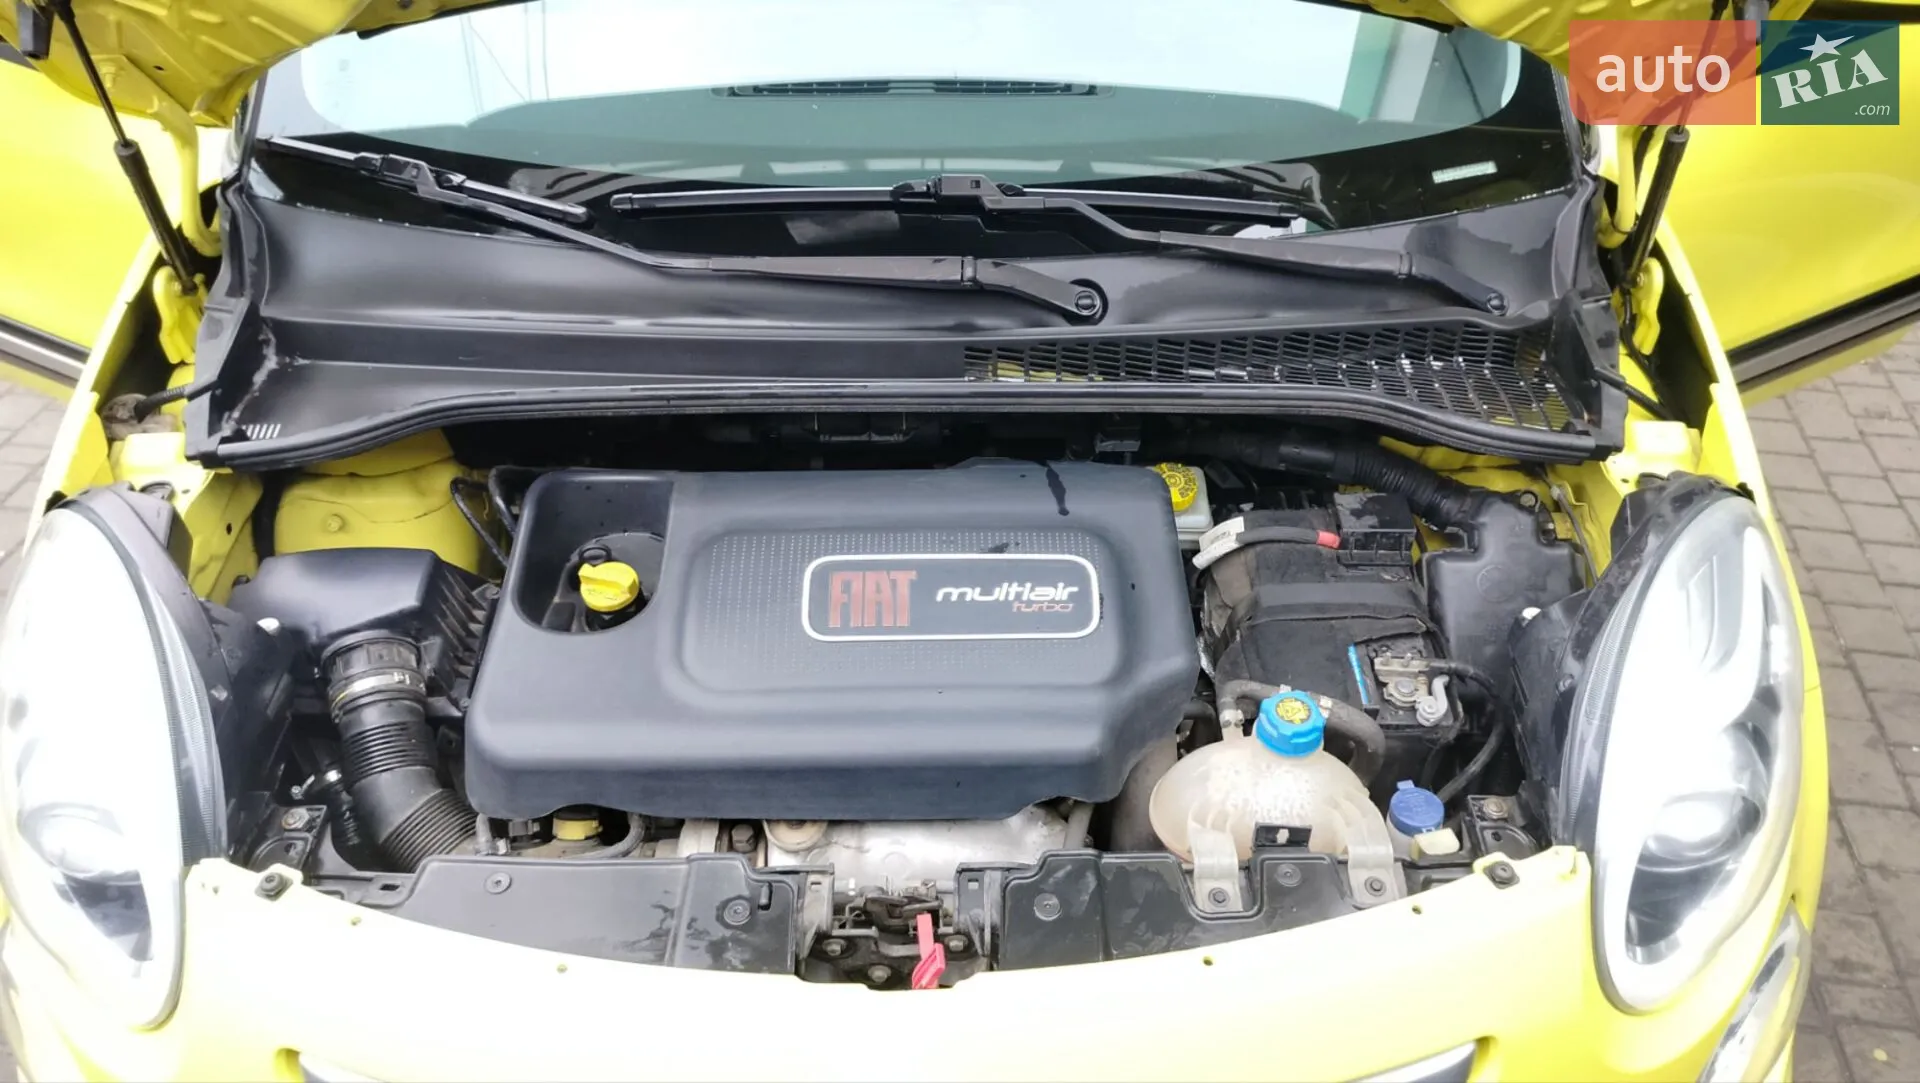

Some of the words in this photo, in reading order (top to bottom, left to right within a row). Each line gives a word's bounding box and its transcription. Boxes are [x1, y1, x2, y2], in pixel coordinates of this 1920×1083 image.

[828, 570, 918, 628] FIAT
[936, 581, 1079, 602] multiair
[1012, 601, 1074, 613] turbo
